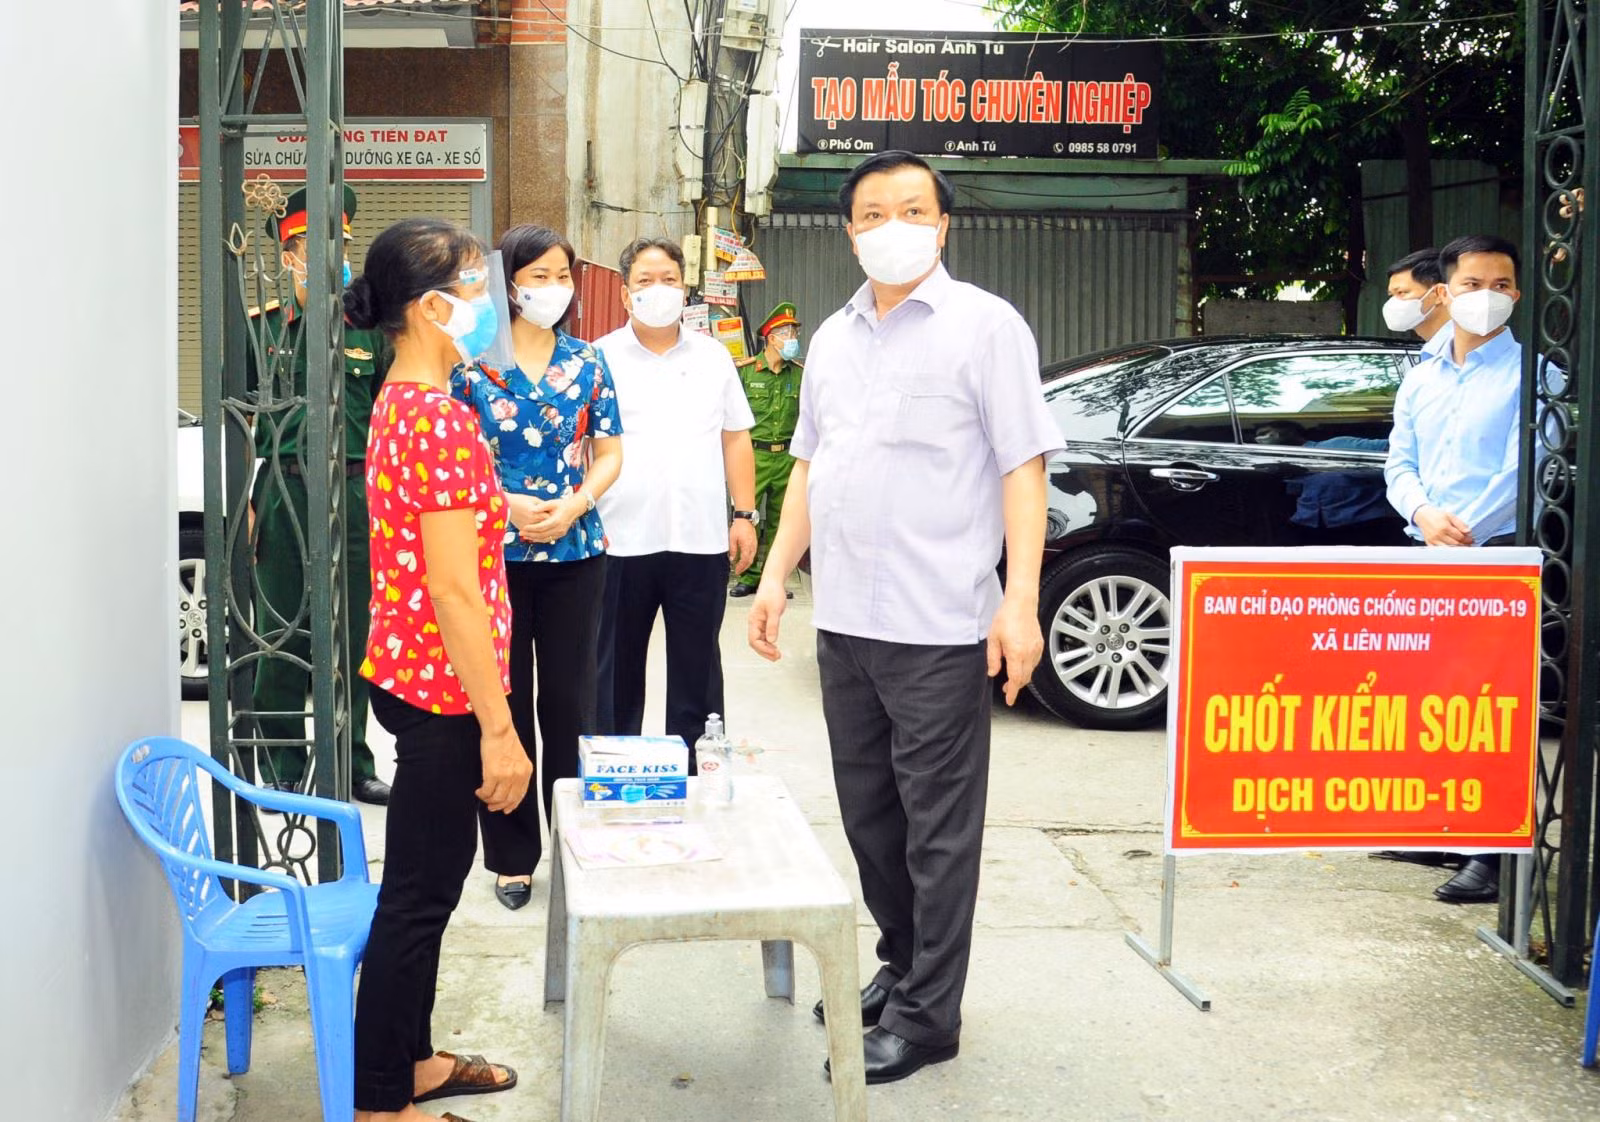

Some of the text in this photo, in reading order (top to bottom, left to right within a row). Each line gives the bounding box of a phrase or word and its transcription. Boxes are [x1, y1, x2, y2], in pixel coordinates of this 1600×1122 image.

[843, 39, 880, 53] Hair
[885, 40, 937, 54] Salon
[941, 41, 977, 54] Anh
[811, 61, 1151, 133] TẠO MẪU TÓC CHUYÊN NGHIỆP
[414, 130, 448, 144] ĐẠT
[829, 137, 873, 150] Phố Om
[956, 140, 996, 152] Anh Tú
[1069, 142, 1136, 153] 0985 58 0791
[245, 149, 272, 165] SỬA
[345, 149, 393, 165] DƯỠNG
[396, 152, 412, 165] XE
[415, 152, 434, 165] GA
[444, 152, 460, 165] XE
[463, 147, 481, 165] SỐ
[1204, 589, 1527, 622] BAN CHỈ ĐẠO PHÒNG CHỐNG DỊCH COVID-19
[1312, 628, 1431, 651] XÃ LIÊN NINH
[1204, 672, 1518, 753] CHỐT KIỂM SOÁT
[596, 763, 679, 774] FACE KISS
[1232, 777, 1481, 820] DỊCH COVID-19
